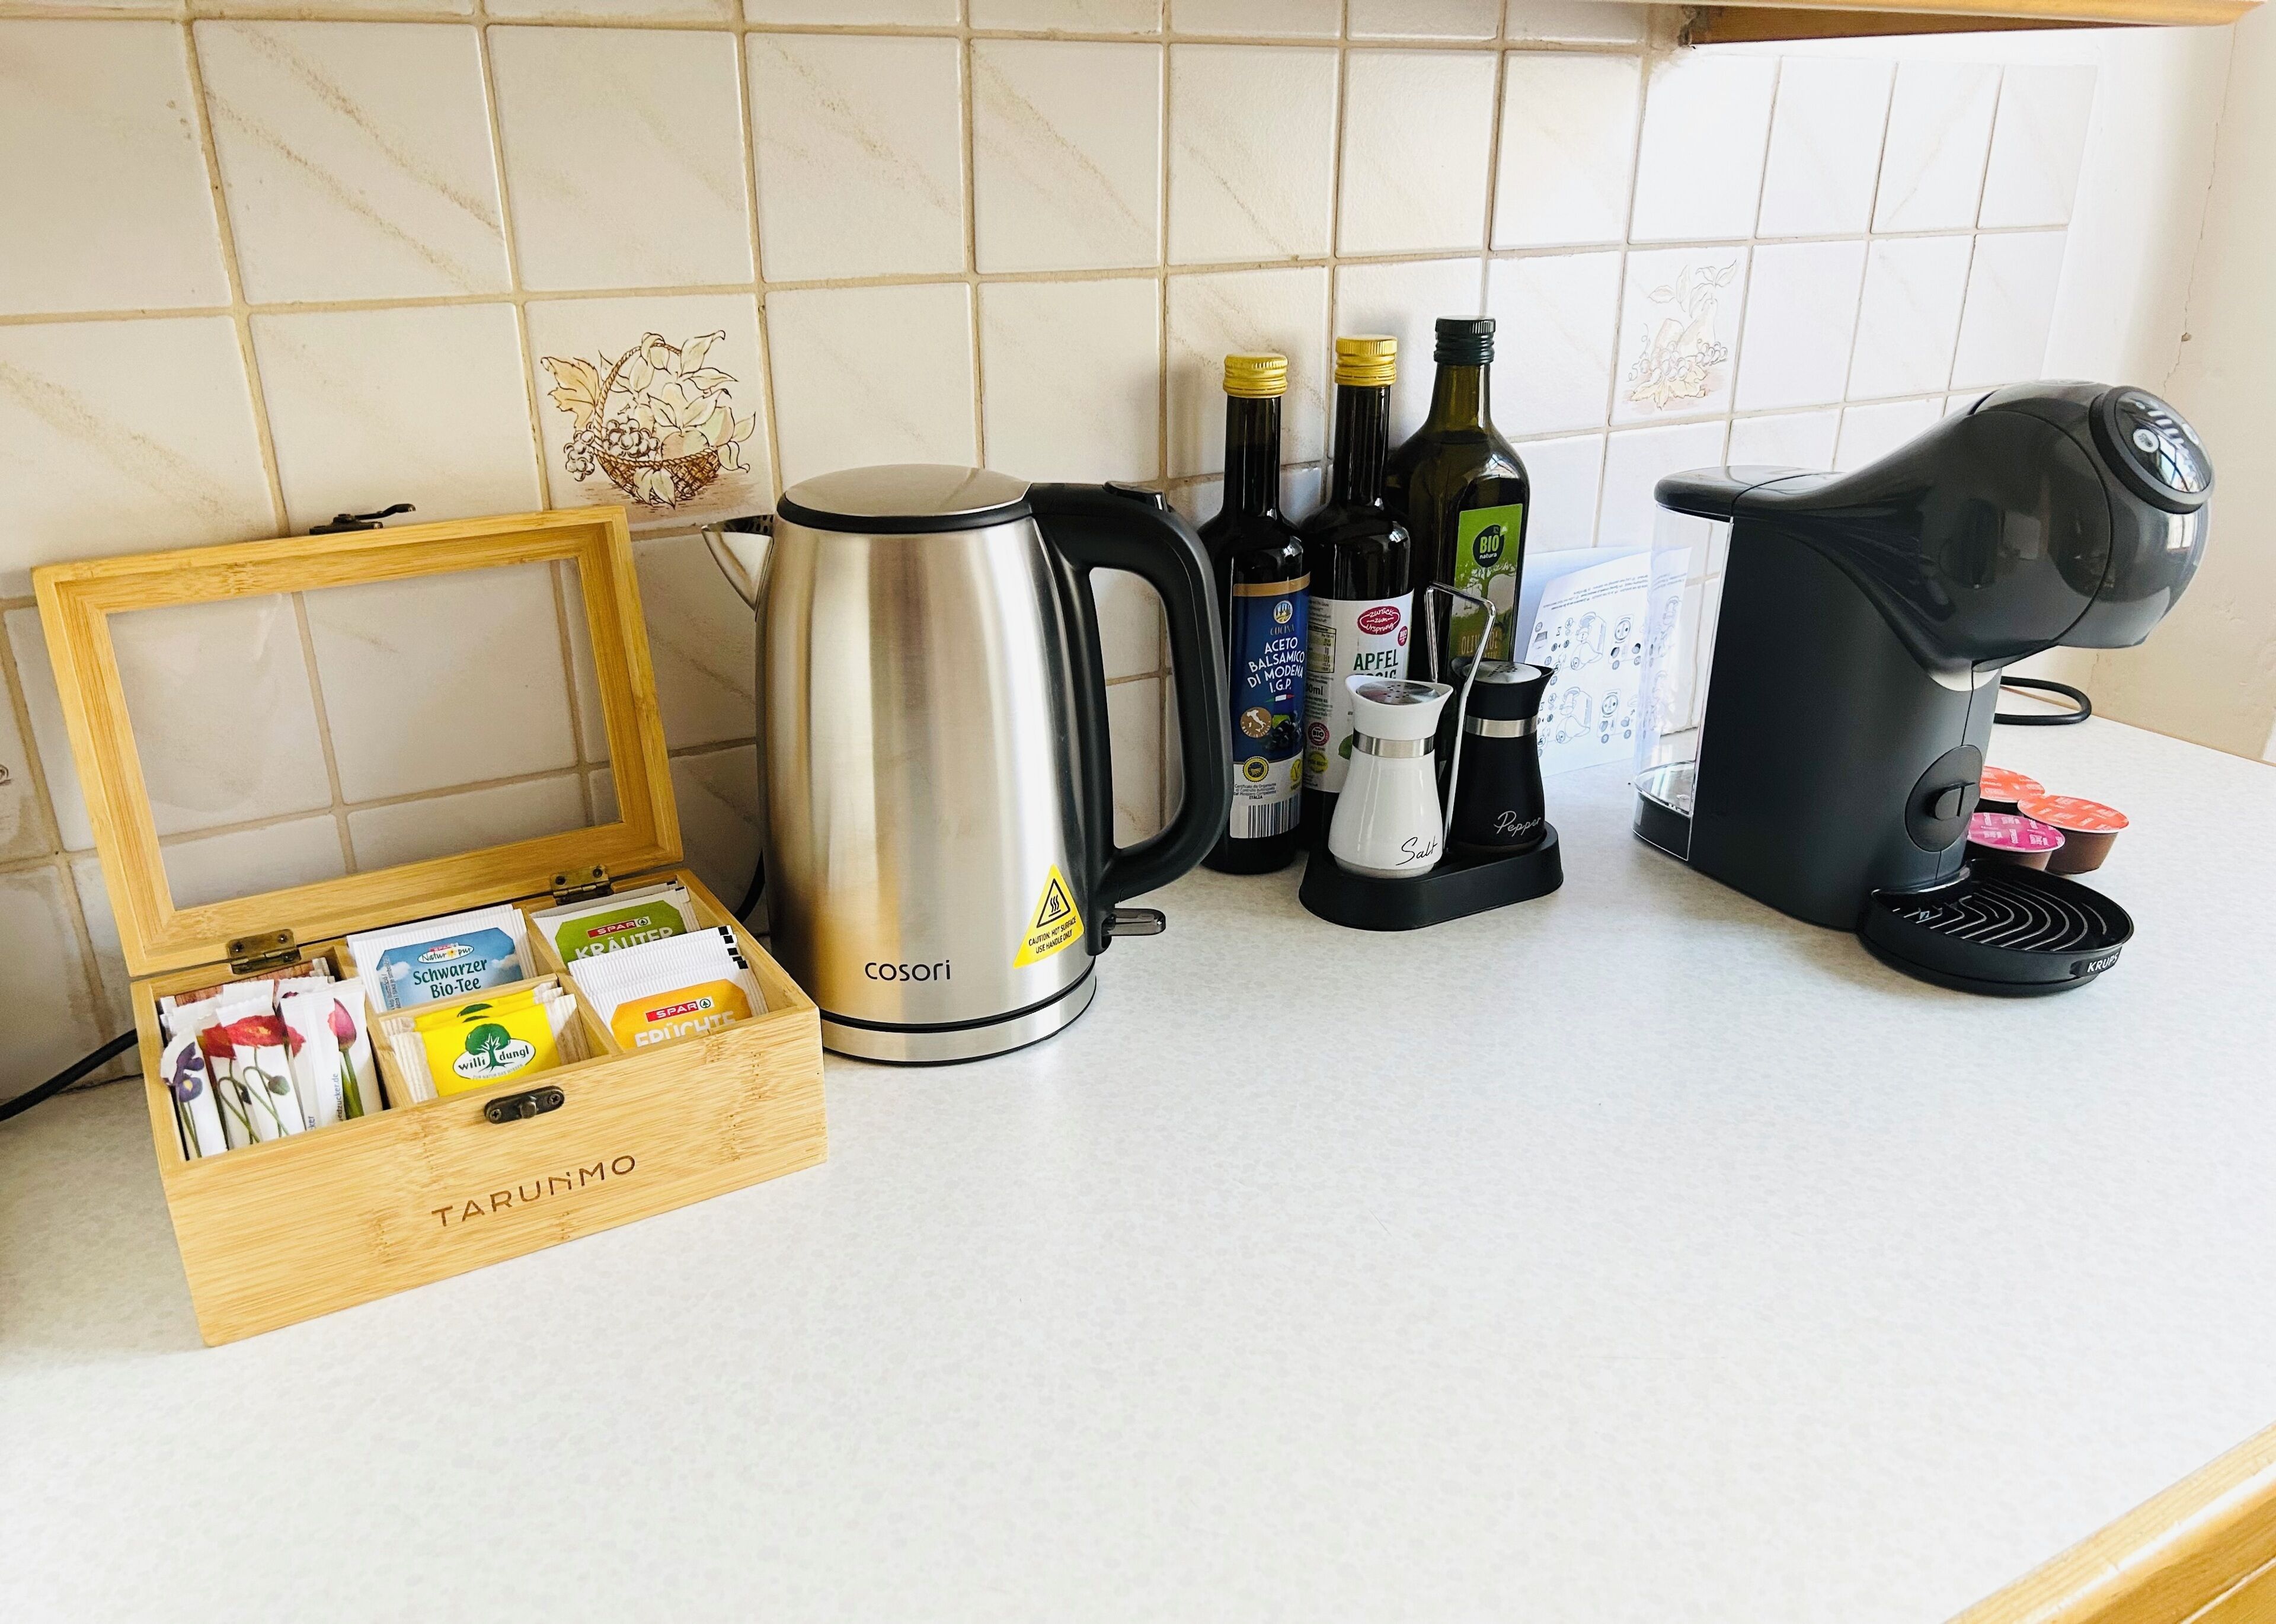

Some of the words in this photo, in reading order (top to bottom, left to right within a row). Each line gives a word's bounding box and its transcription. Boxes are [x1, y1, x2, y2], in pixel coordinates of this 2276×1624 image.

[1479, 534, 1500, 554] BIO
[1479, 552, 1497, 560] natura
[1370, 608, 1394, 618] zurück
[1366, 622, 1394, 634] Ursprung
[1264, 637, 1298, 654] ACETO
[1461, 629, 1498, 655] OLIVÖL
[1248, 651, 1305, 673] BALSAMICO
[1353, 649, 1398, 670] APFEL
[1247, 673, 1261, 688] DI
[1264, 664, 1303, 682] MODENA
[1269, 678, 1292, 693] I.G.P.
[1494, 810, 1542, 837] Pepper
[1395, 835, 1438, 866] Salt
[597, 922, 636, 935] SPAR
[1051, 926, 1060, 936] HOT
[1060, 915, 1076, 932] SURFACE
[575, 926, 673, 960] KRÄUTER
[1036, 944, 1046, 954] USE
[1046, 935, 1063, 949] HANDLE
[1063, 929, 1073, 941] ONLY
[421, 951, 446, 961] Natur
[458, 947, 472, 957] pur
[2087, 952, 2119, 973] KRUPS
[413, 959, 487, 985] Schwarzer
[865, 960, 951, 982] cosori
[430, 977, 481, 999] Bio-Tee
[656, 1003, 698, 1018] SPAR
[635, 1011, 736, 1047] FRÜCHTE
[458, 1056, 486, 1071] willi
[499, 1045, 529, 1062] dungl
